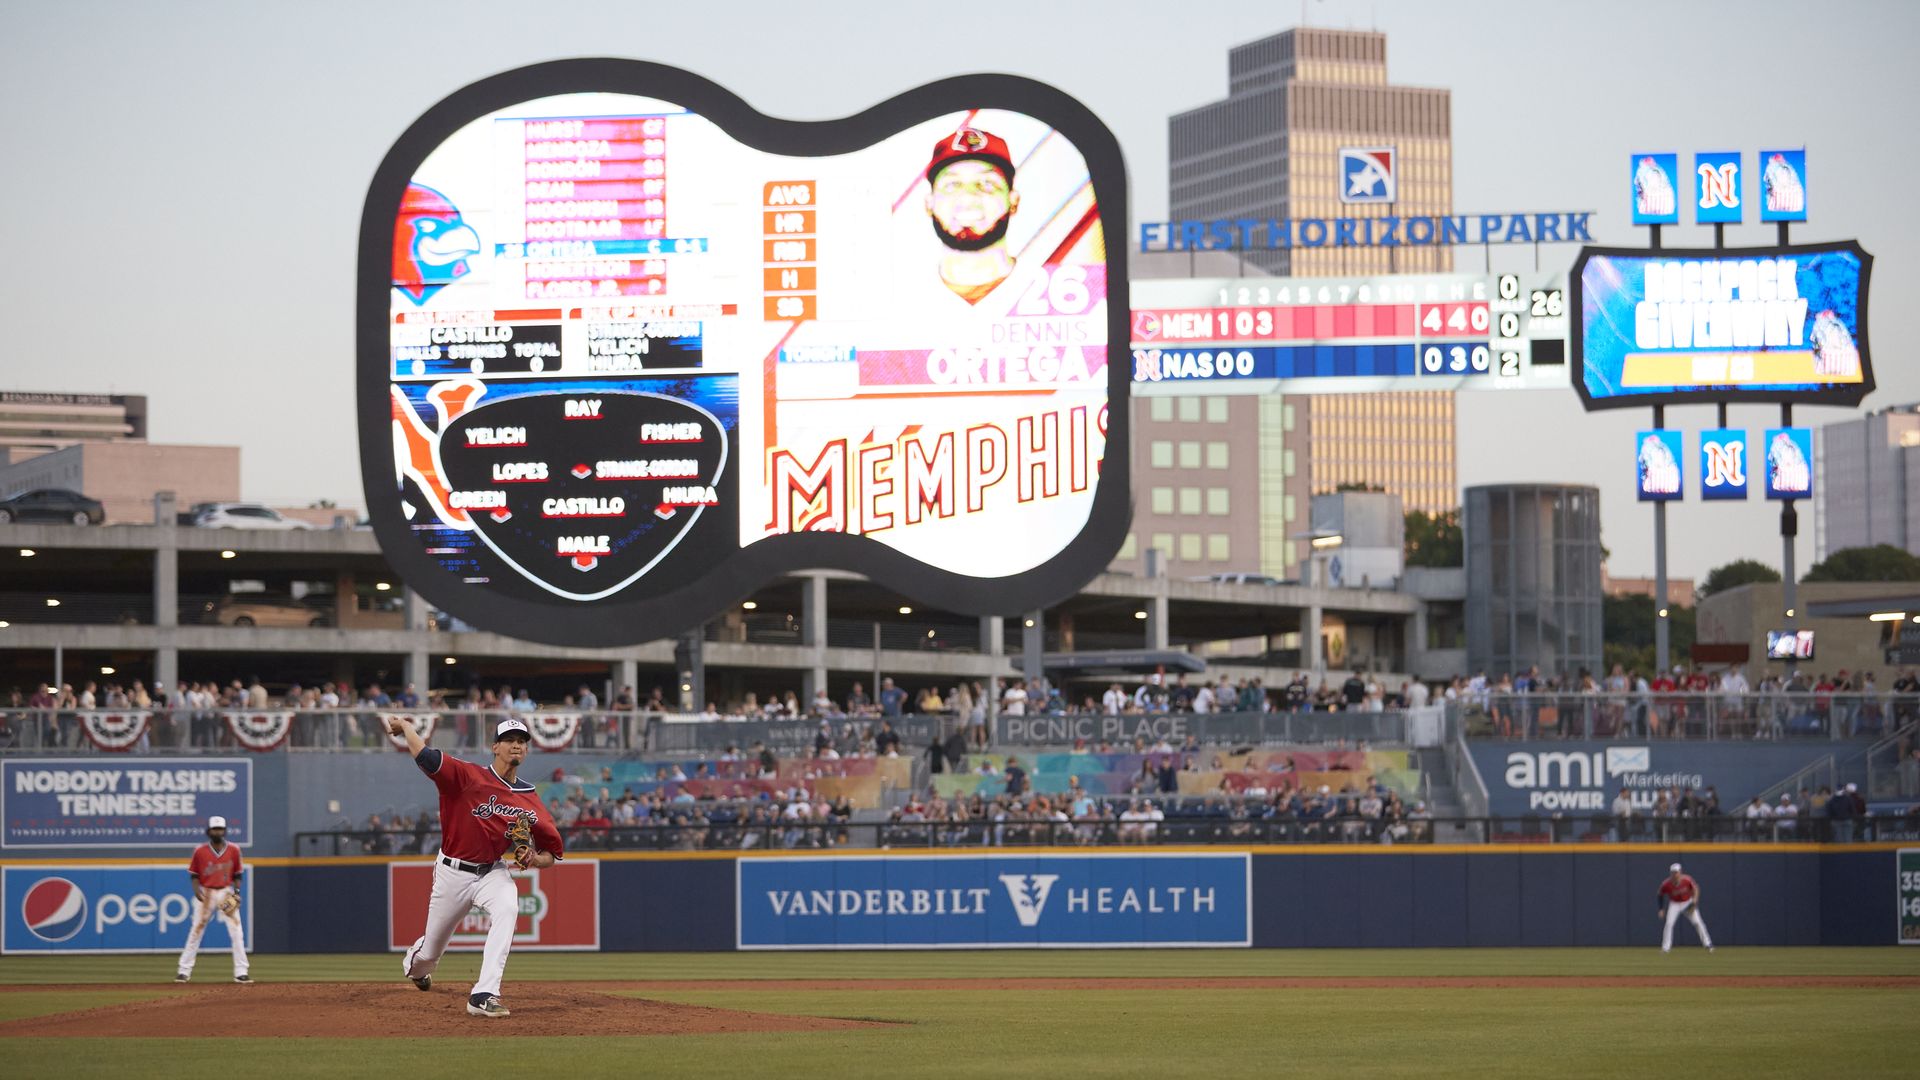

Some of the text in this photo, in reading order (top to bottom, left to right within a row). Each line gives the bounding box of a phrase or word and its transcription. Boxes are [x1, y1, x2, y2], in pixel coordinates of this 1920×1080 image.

[768, 184, 811, 206] AVG
[775, 212, 805, 233] HR
[1140, 212, 1592, 253] FIRST HORIZON PARK
[648, 239, 662, 254] C
[773, 241, 806, 261] RBI
[781, 269, 798, 289] H
[1500, 274, 1519, 300] 0
[1016, 265, 1091, 316] 26
[1218, 288, 1229, 305] 1
[1238, 287, 1251, 305] 2
[1258, 287, 1271, 304] 3
[1276, 286, 1291, 304] 4
[1299, 286, 1312, 304] 5
[1318, 286, 1331, 303] 6
[1338, 285, 1351, 303] 7
[1473, 282, 1487, 299] E
[1531, 291, 1562, 317] 26
[991, 321, 1088, 344] DENNIS
[1162, 306, 1489, 339] MEM 1 0 3 4 4 0
[1500, 312, 1519, 338] 0
[431, 326, 514, 344] CASTILLO
[513, 342, 561, 358] TOTAL
[470, 358, 485, 375] 0
[529, 357, 544, 373] 0
[925, 347, 1090, 385] ORTEGA
[1163, 352, 1214, 378] NAS
[1216, 351, 1234, 376] 0
[1236, 351, 1254, 376] 0
[1424, 347, 1442, 372] 0
[1450, 346, 1468, 371] 3
[1471, 346, 1490, 371] 0
[1501, 351, 1519, 376] 2
[564, 400, 602, 417] RAY
[465, 427, 527, 445] YELICH
[641, 423, 703, 441] FISHER
[492, 462, 549, 480] LOPES
[449, 490, 507, 508] GREEN
[663, 486, 719, 504] HIURA
[542, 497, 626, 516] CASTILLO
[557, 535, 611, 554] MAILE
[1007, 717, 1188, 740] PICNIC PLACE
[16, 770, 237, 793] NOBODY TRASHES
[1622, 771, 1703, 790] Marketing
[56, 793, 197, 816] TENNESSEE
[1530, 791, 1604, 810] POWER
[766, 888, 991, 917] VANDERBILT
[1067, 886, 1215, 914] HEALTH
